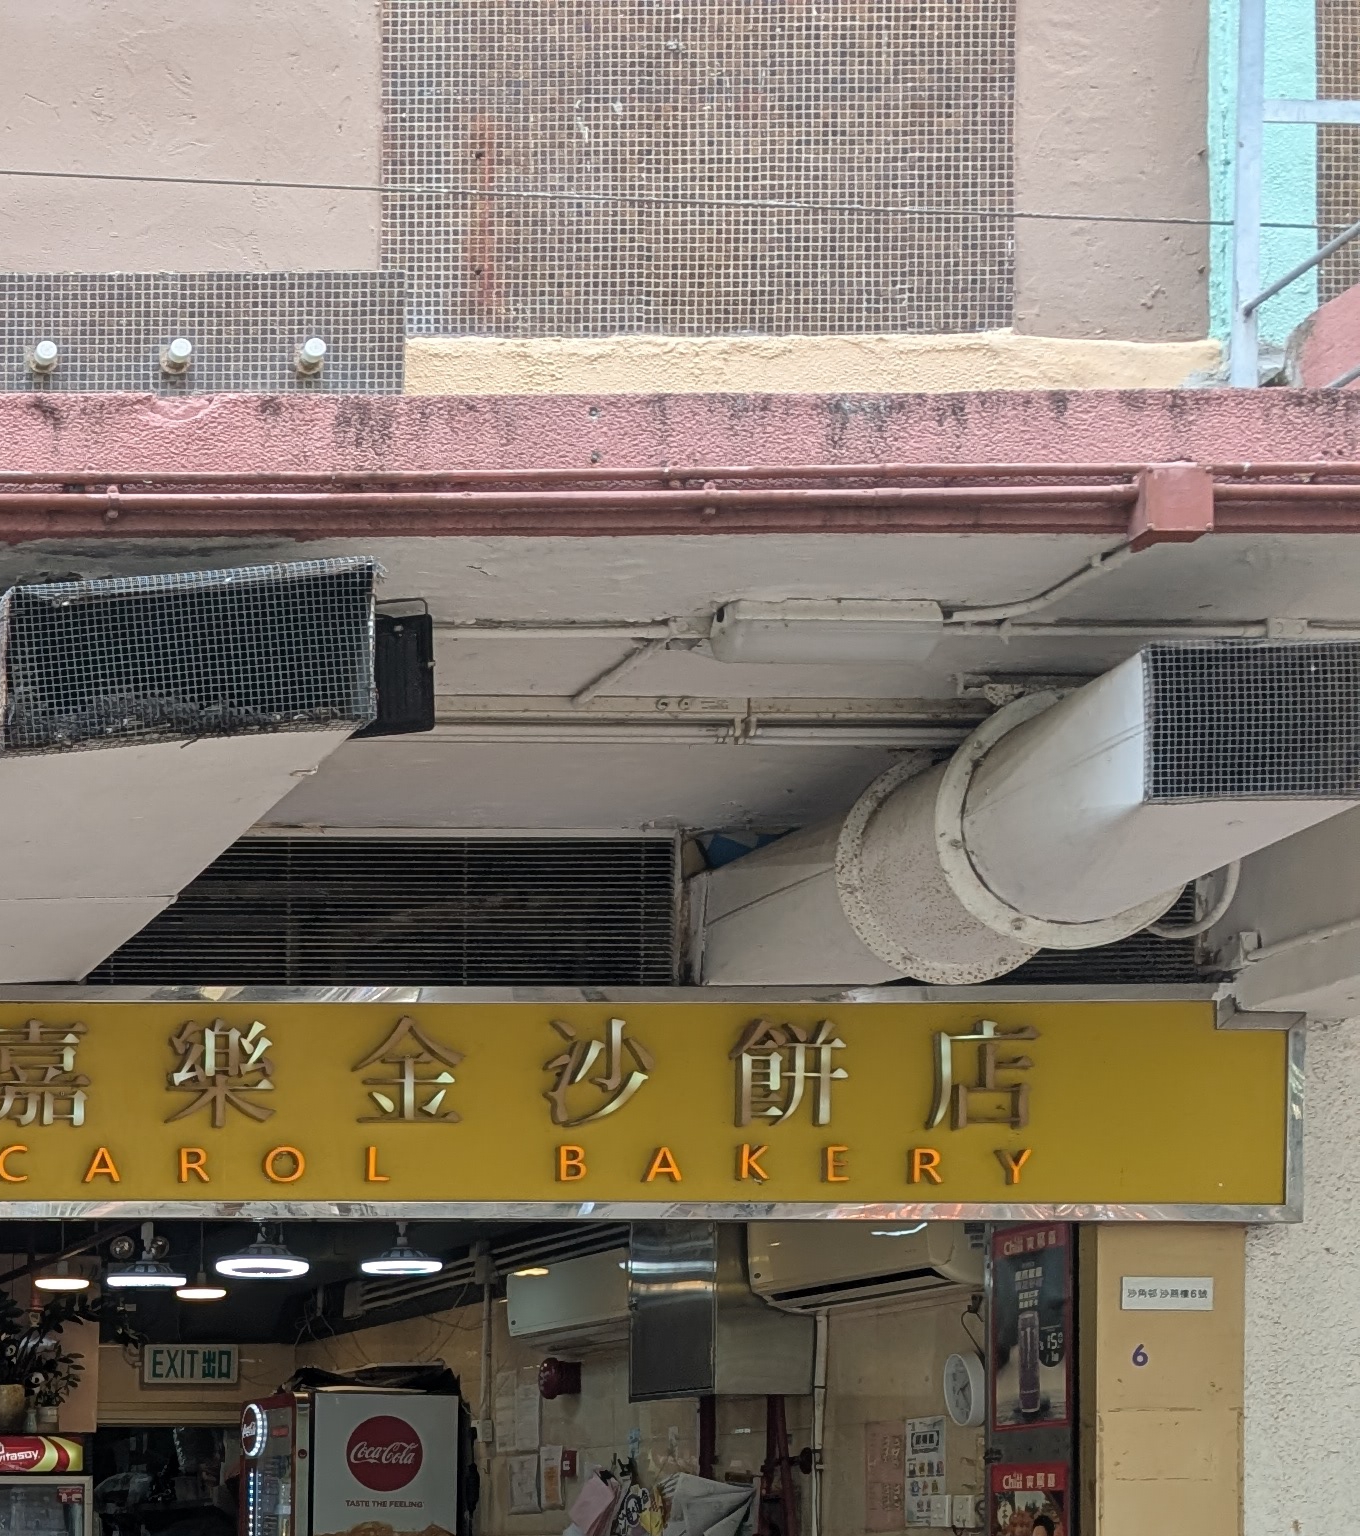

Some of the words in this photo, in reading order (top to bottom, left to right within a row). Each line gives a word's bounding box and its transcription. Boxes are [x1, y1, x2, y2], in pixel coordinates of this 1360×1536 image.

[556, 1144, 1033, 1186] BAKERY
[152, 1349, 199, 1379] EXIT
[201, 1350, 232, 1379] 出口
[1132, 1343, 1149, 1367] 6
[350, 1441, 420, 1465] Coca-Cola
[345, 1499, 370, 1508] TASTE
[371, 1500, 388, 1508] THE
[388, 1500, 423, 1508] FEELING
